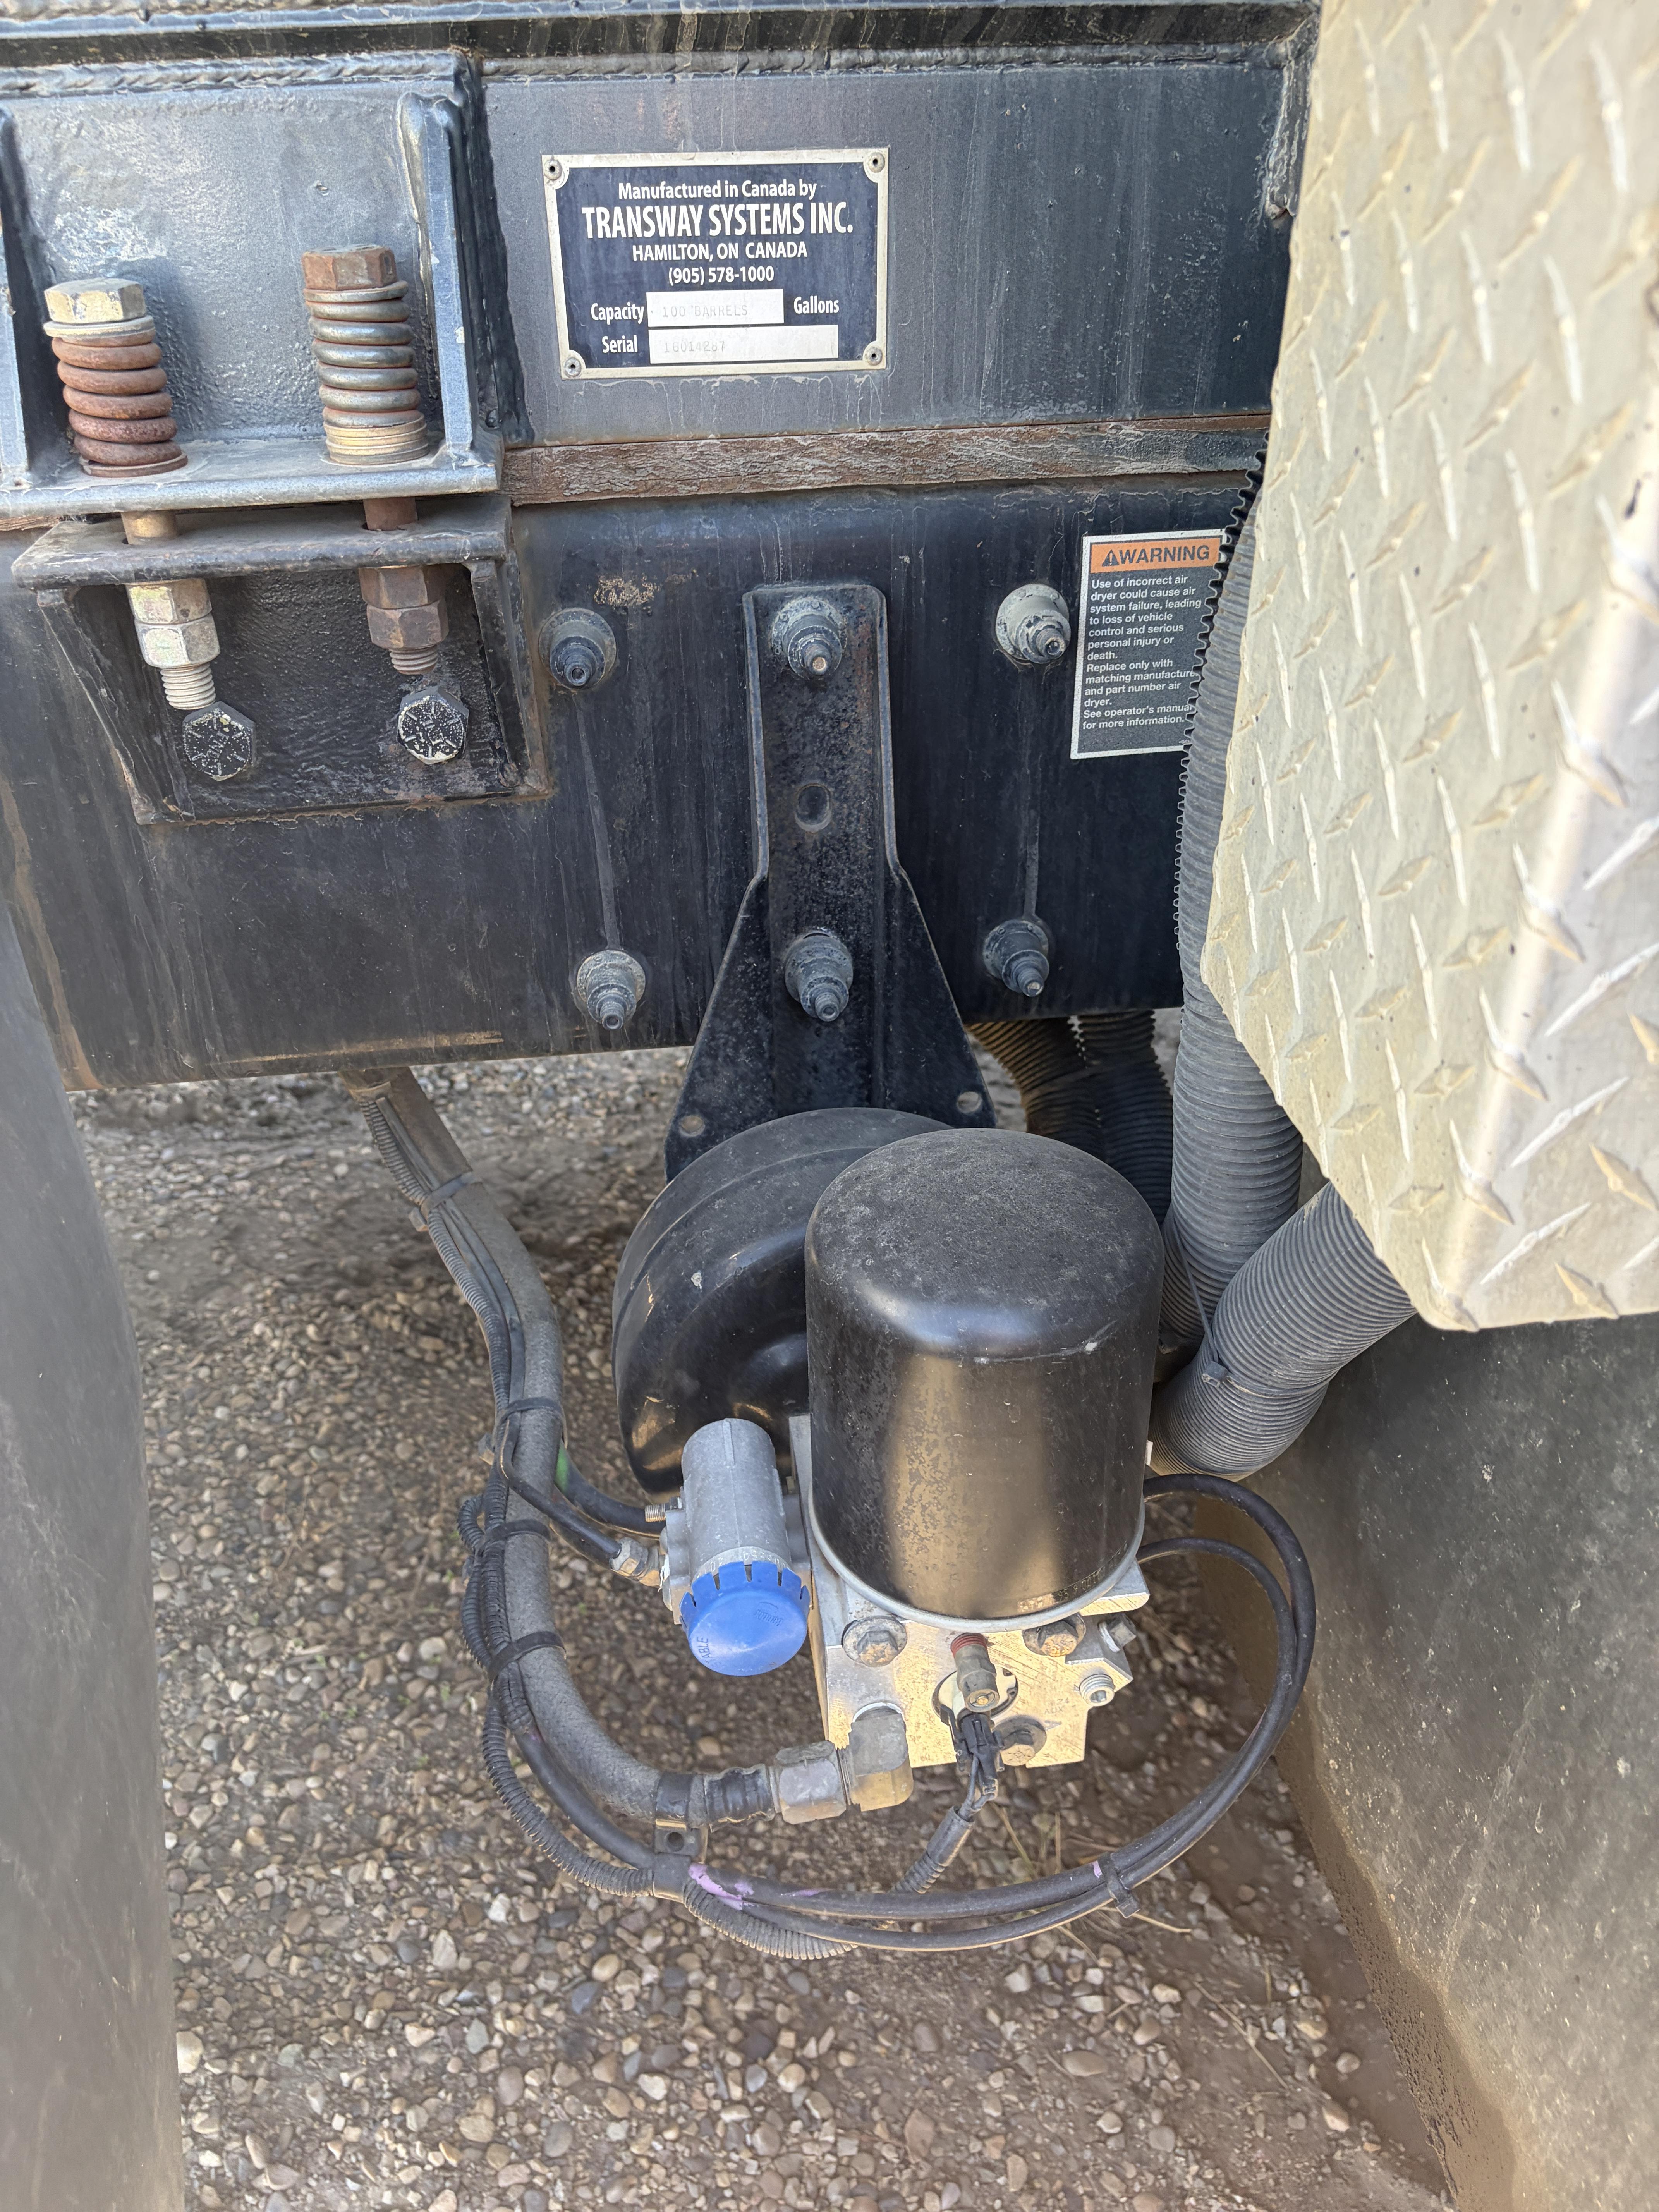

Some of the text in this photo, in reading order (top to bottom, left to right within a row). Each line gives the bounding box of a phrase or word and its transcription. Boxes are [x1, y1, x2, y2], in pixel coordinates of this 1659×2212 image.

[619, 179, 817, 200] Manufactured in Canada by
[582, 202, 853, 238] TRANSWAY SYSTEMS INC.
[633, 242, 807, 261] HAMILTON, ON CANADA
[669, 266, 774, 286] (905) 578-1000
[591, 296, 839, 325] Capacity 100 BARRELS Gallons
[602, 335, 637, 353] Serial
[1119, 545, 1209, 564] WARNING
[1092, 575, 1188, 589] Use of incorrect air
[1091, 592, 1117, 602] dryer
[1120, 589, 1147, 599] could
[1183, 587, 1196, 595] air
[1091, 599, 1201, 614] system failure, leading
[1103, 616, 1122, 624] loss
[1125, 614, 1135, 622] of
[1138, 612, 1173, 622] vehicle
[1089, 624, 1183, 636] control and serious
[1088, 639, 1130, 650] personal
[1134, 637, 1161, 647] injury
[1087, 651, 1118, 660] death.
[1087, 659, 1173, 673] Replace only with
[1086, 670, 1197, 684] matching manufacture
[1085, 681, 1181, 696] and part number air
[1084, 699, 1112, 708] dryer.
[1104, 706, 1154, 718] operator's
[1127, 716, 1184, 726] information.
